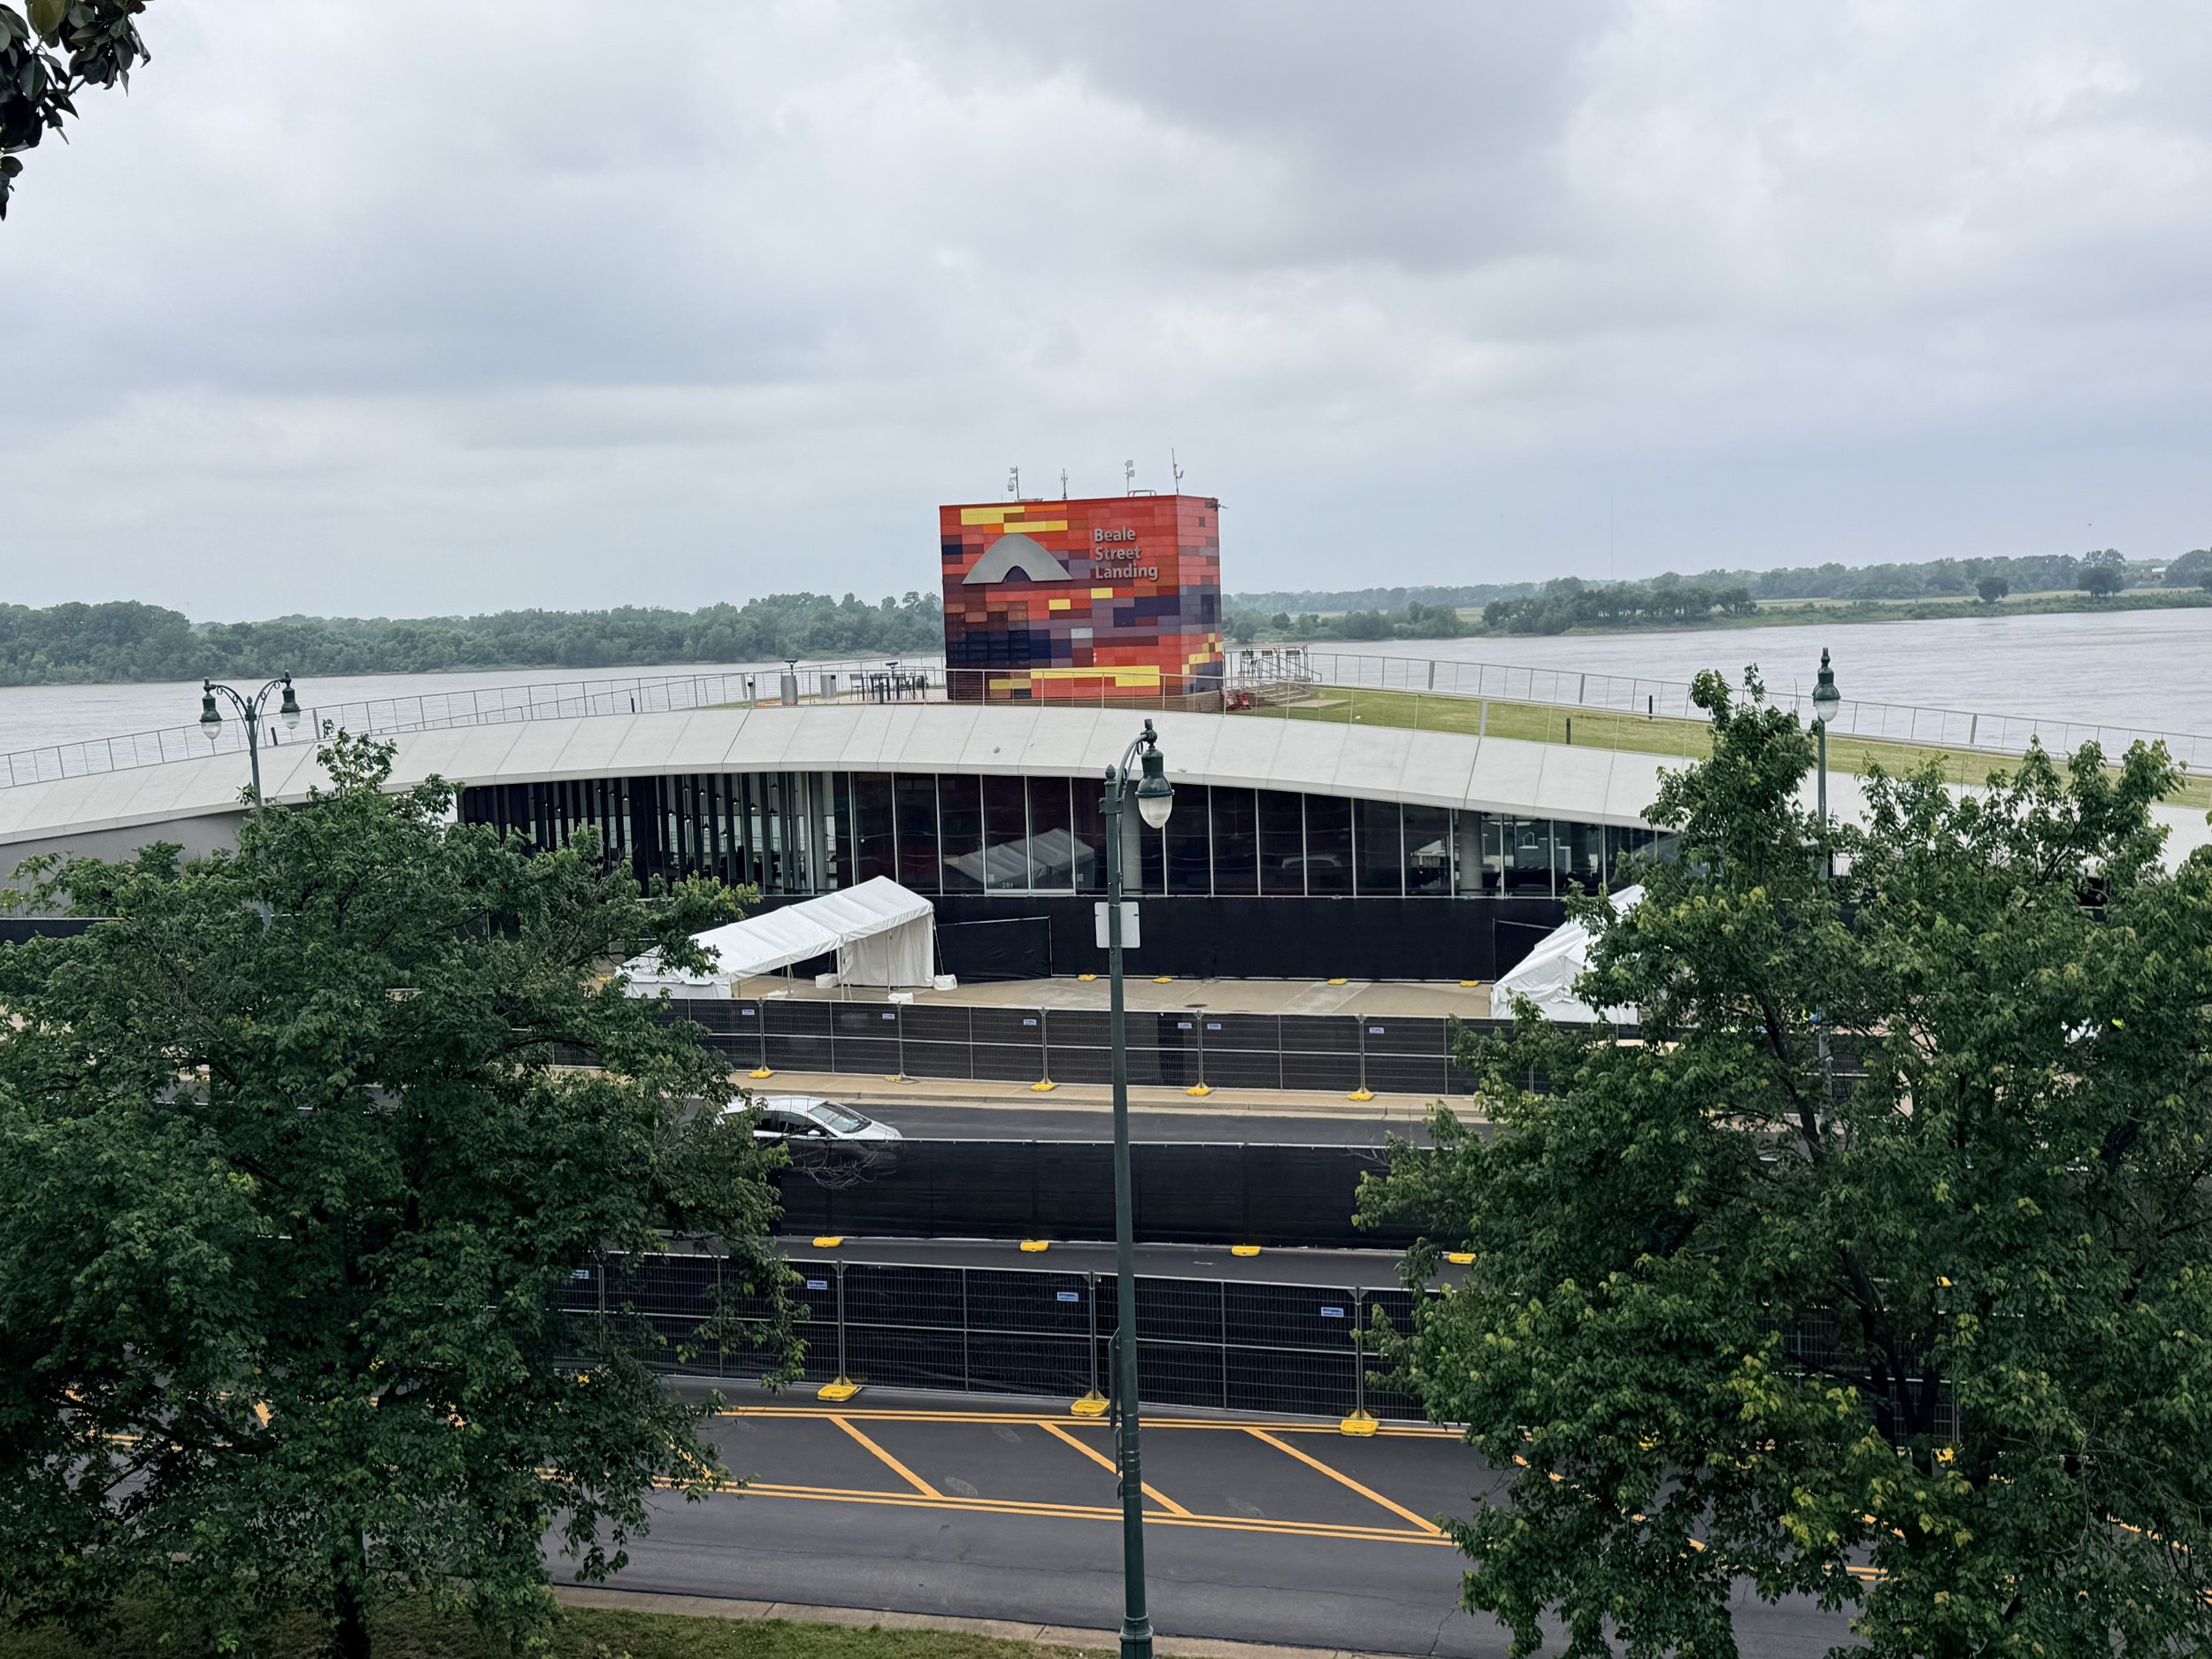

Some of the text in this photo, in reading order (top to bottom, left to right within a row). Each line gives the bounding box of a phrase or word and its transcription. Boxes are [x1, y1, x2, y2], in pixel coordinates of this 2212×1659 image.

[1094, 526, 1136, 542] Beale
[1094, 546, 1141, 561] Street
[1095, 563, 1158, 581] Landing
